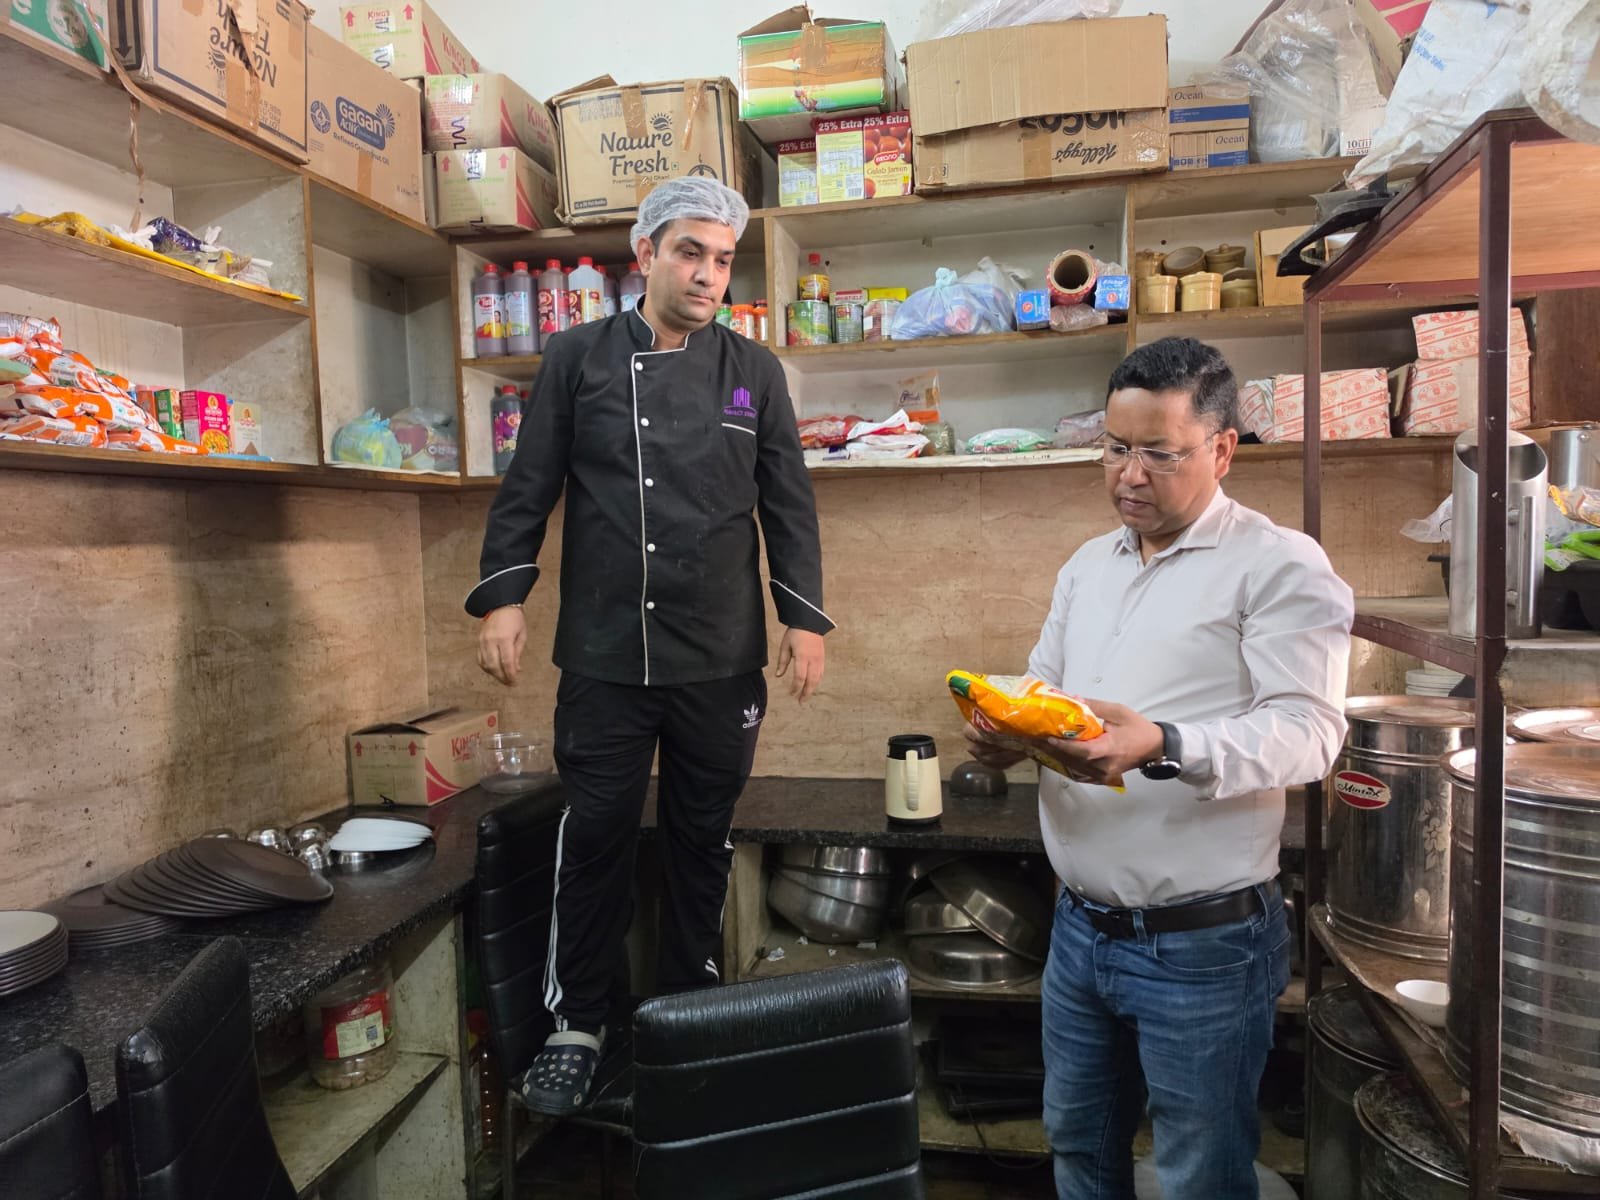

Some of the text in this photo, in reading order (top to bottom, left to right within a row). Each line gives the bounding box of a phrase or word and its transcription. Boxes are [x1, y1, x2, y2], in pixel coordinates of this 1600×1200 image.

[209, 26, 277, 88] Naure
[1174, 91, 1204, 101] Ocean
[818, 119, 862, 132] 25% Extra
[864, 114, 909, 127] 25% Extra
[779, 140, 816, 152] 25% Extr
[1215, 135, 1245, 145] Ocean
[1053, 141, 1117, 166] Kellogg's
[608, 150, 670, 177] Fresh
